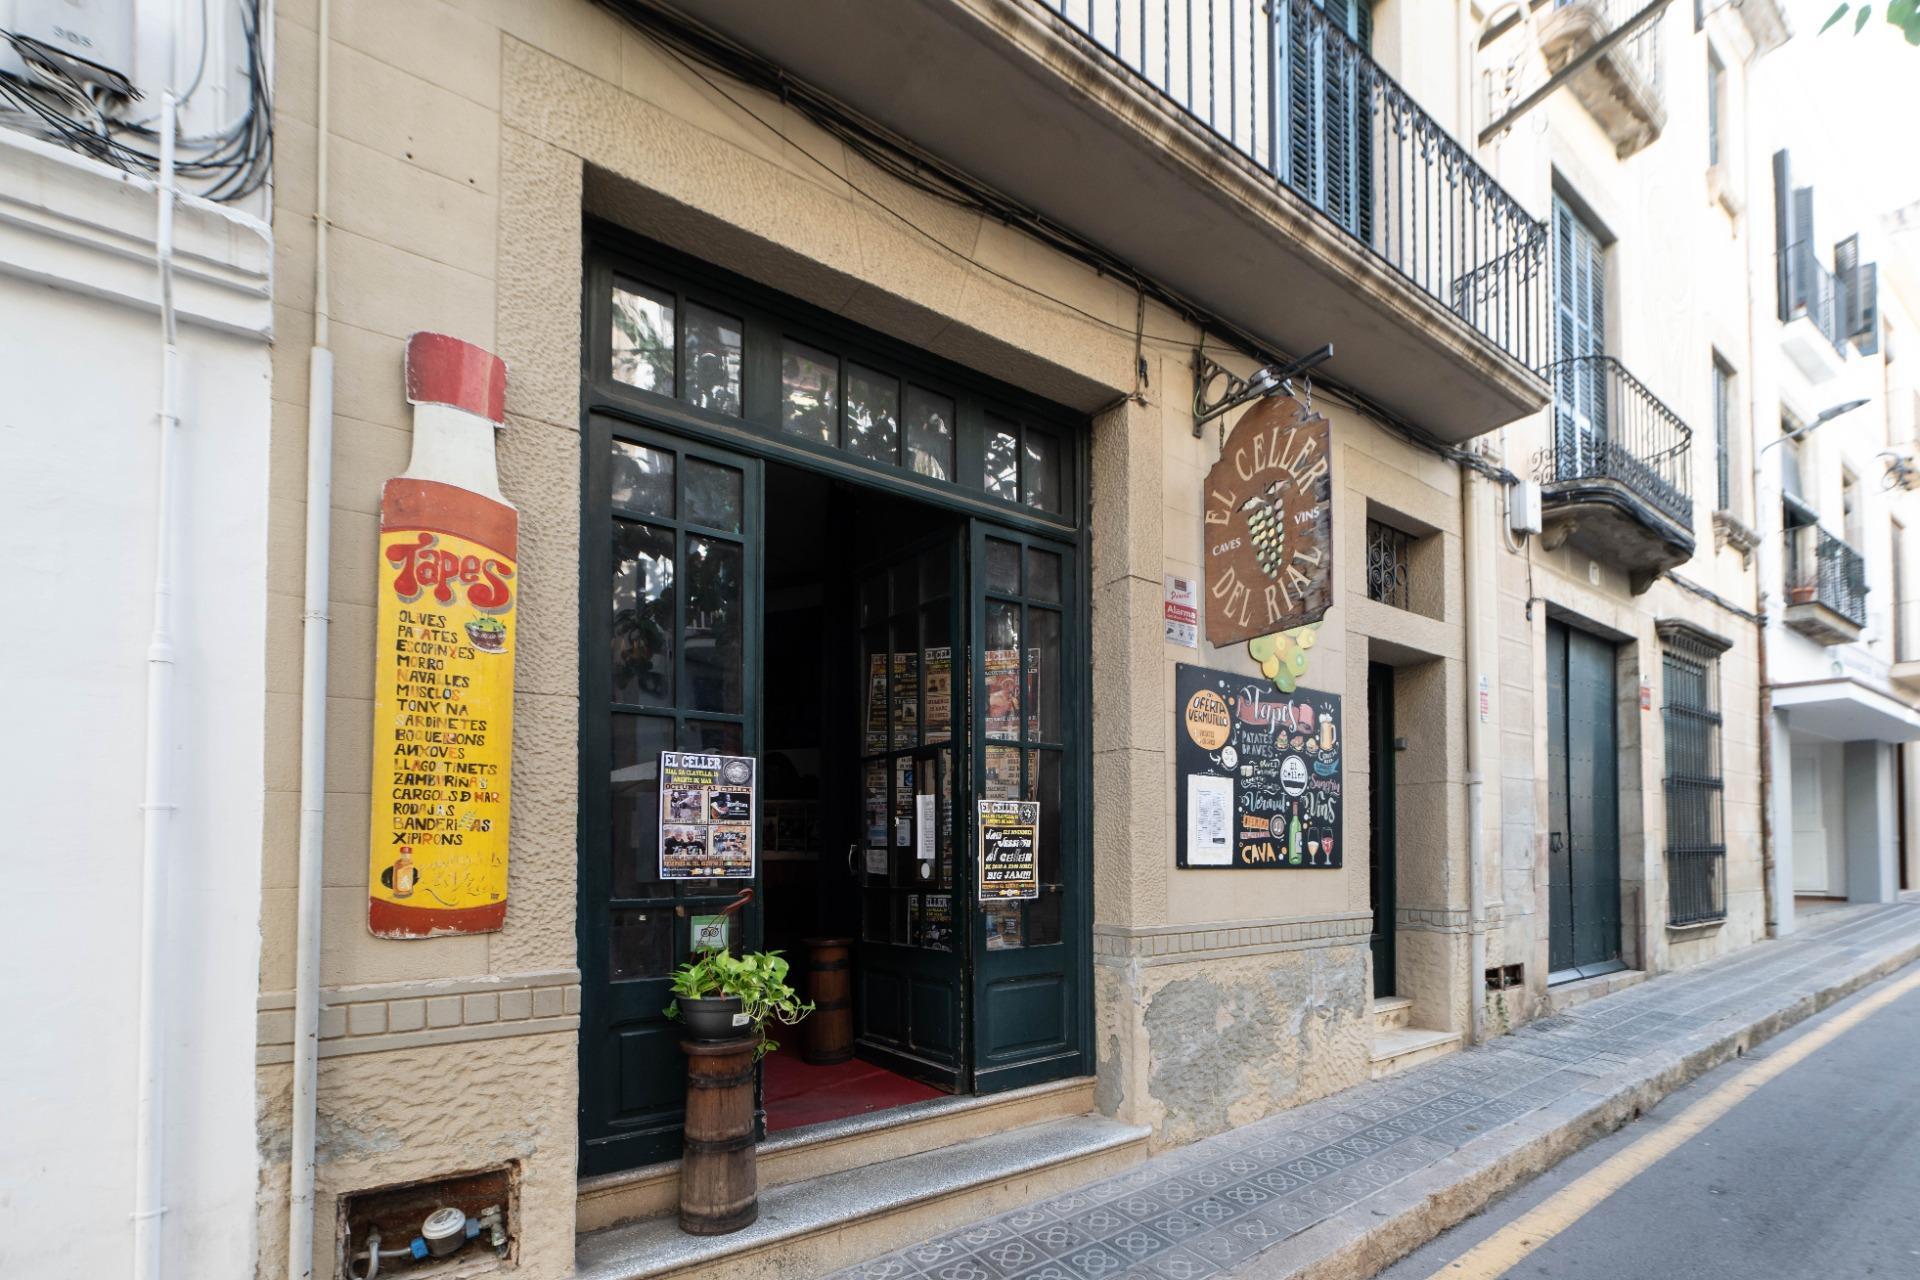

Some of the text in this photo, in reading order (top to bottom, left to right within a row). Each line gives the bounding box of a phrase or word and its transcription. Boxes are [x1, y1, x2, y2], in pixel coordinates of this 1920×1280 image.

[1205, 426, 1328, 526] EL CELLER
[1294, 506, 1320, 525] VINS
[1212, 537, 1241, 556] CAVES
[1212, 545, 1322, 627] DEL RIAL
[1167, 604, 1196, 619] Alarma
[397, 655, 444, 671] MORRO
[396, 684, 460, 701] MUSCLOS
[1193, 696, 1227, 715] OFERTA
[1240, 685, 1297, 734] Tapes
[1241, 730, 1274, 744] PATATES
[394, 743, 465, 759] ANXOVES
[1241, 744, 1274, 758] BRAVES
[665, 754, 721, 770] EL CELLER
[1290, 762, 1298, 771] El
[1283, 769, 1305, 780] Celler
[392, 788, 458, 802] CARGOLS
[474, 791, 500, 803] MAR
[980, 802, 1019, 814] EL CELLER
[1301, 790, 1336, 823] Vins
[1241, 842, 1277, 864] CAVA
[987, 871, 1004, 880] BIG
